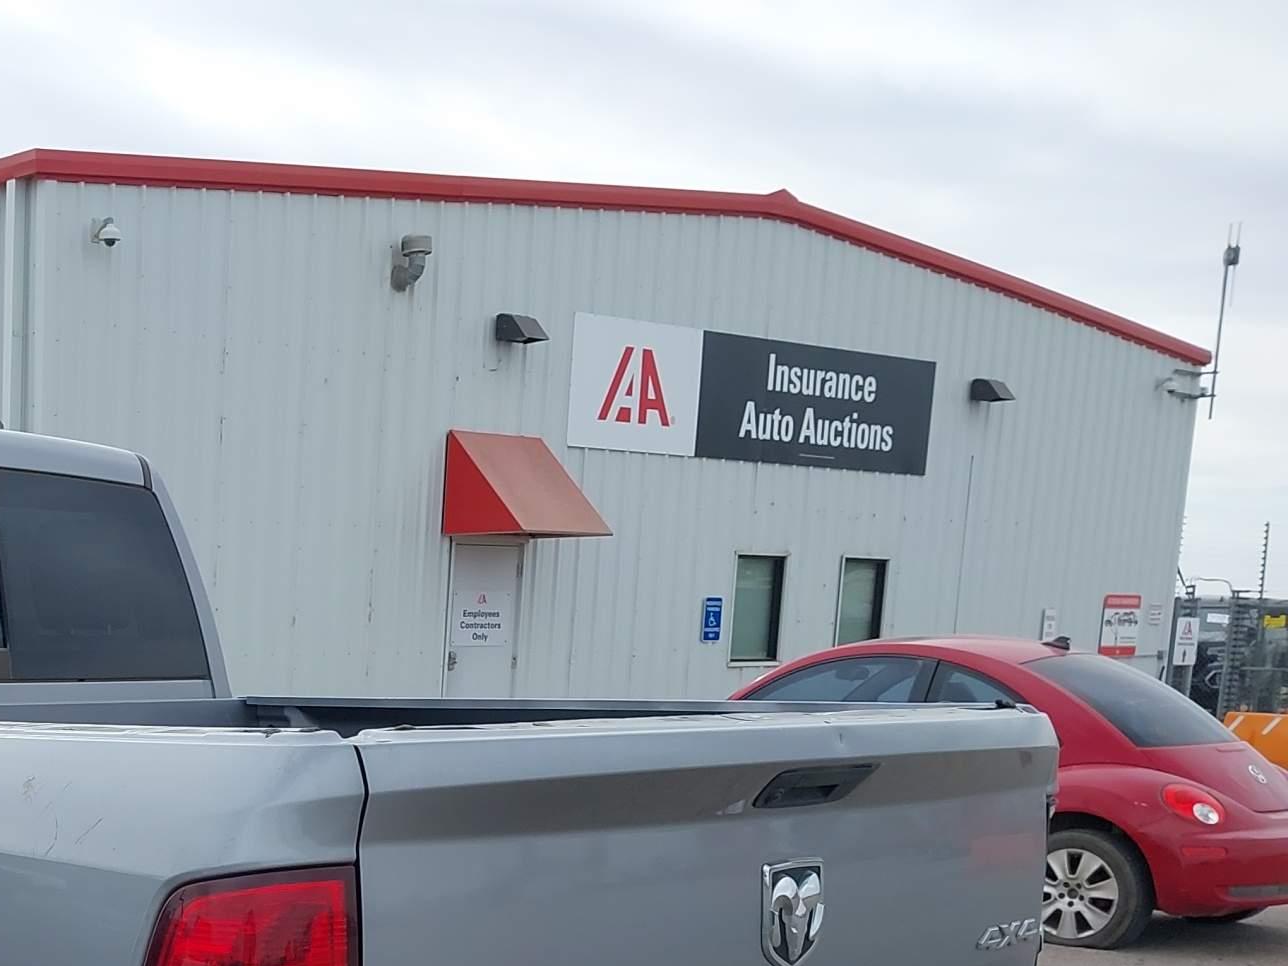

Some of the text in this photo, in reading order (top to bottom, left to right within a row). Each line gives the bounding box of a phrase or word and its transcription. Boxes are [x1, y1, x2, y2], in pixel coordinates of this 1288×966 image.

[766, 352, 878, 403] Insurance
[738, 400, 894, 453] Auto Auctions
[462, 609, 500, 619] Employees
[459, 620, 501, 629] Contractors
[471, 632, 488, 643] Only
